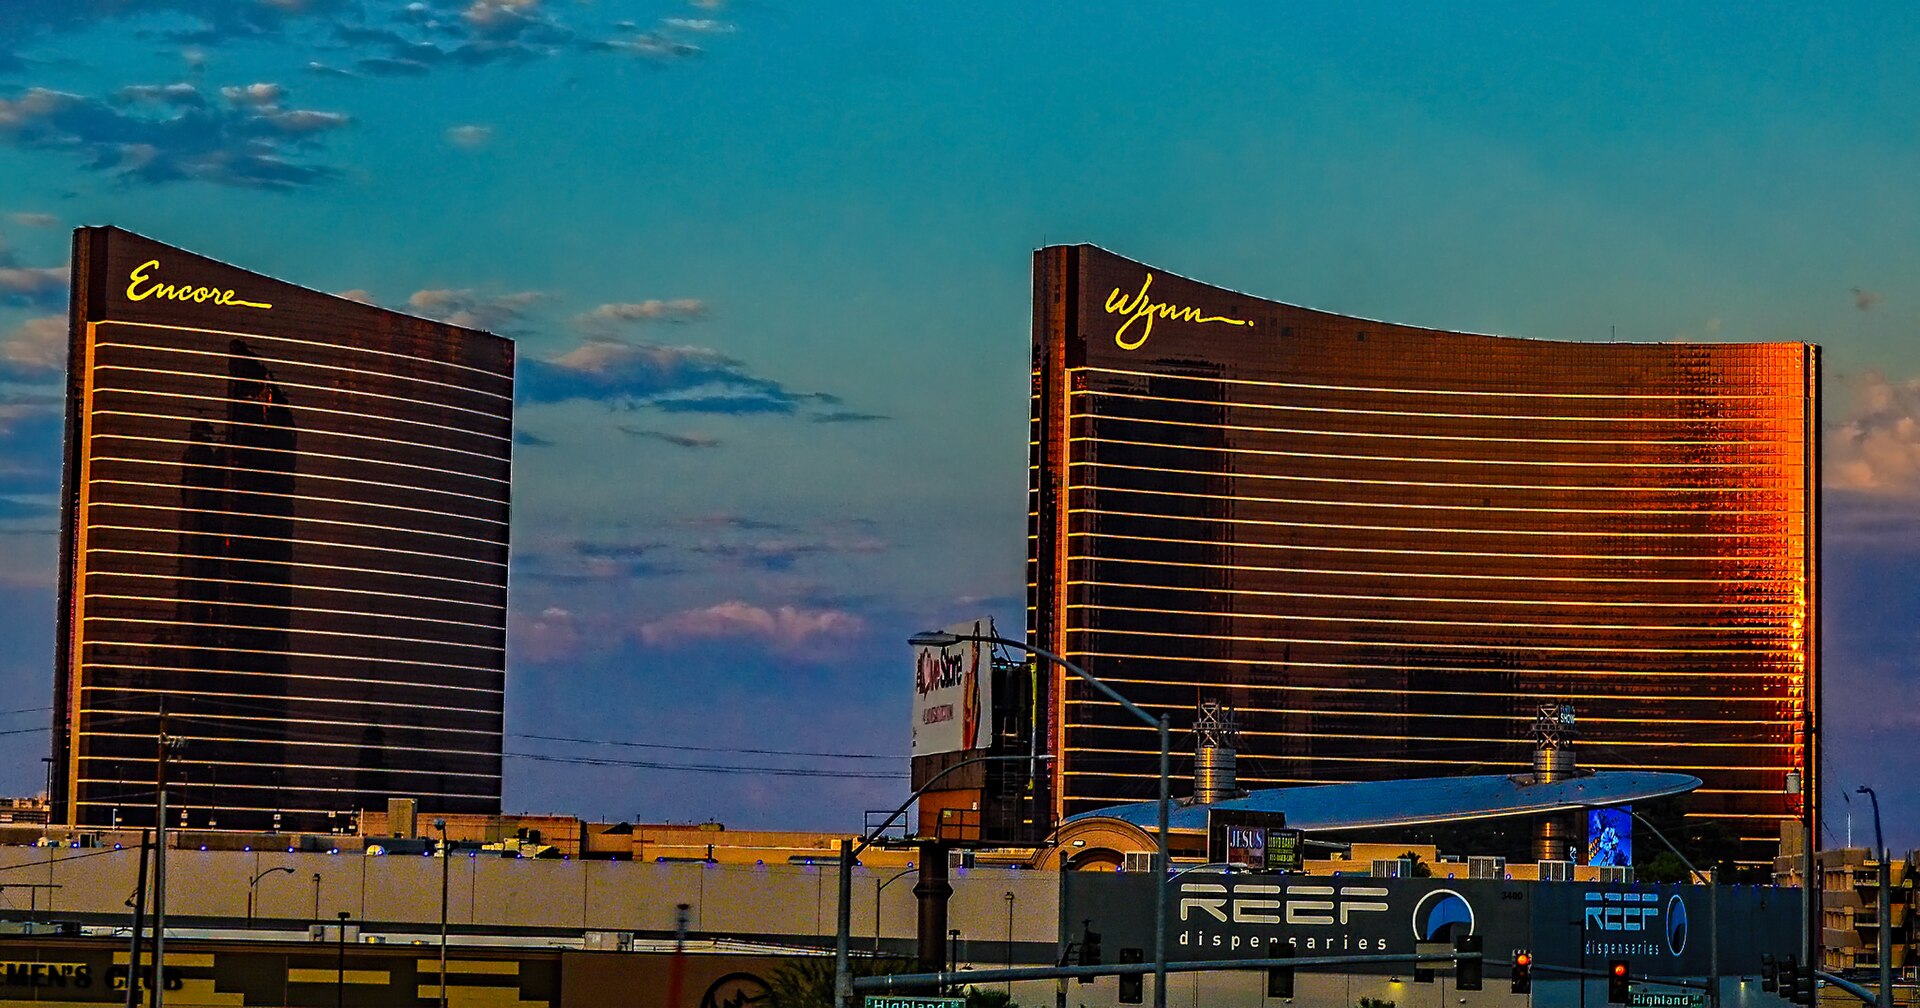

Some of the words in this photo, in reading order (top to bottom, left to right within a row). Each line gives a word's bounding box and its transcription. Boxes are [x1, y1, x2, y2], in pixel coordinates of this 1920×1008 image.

[127, 259, 273, 309] Encore
[1230, 830, 1264, 848] JESUS
[1180, 883, 1389, 925] REEF
[1585, 892, 1658, 931] REEF
[1179, 931, 1387, 950] dispensaries
[1585, 940, 1659, 957] dispensaries
[0, 962, 92, 989] MEN'S
[1633, 994, 1688, 1006] Highland
